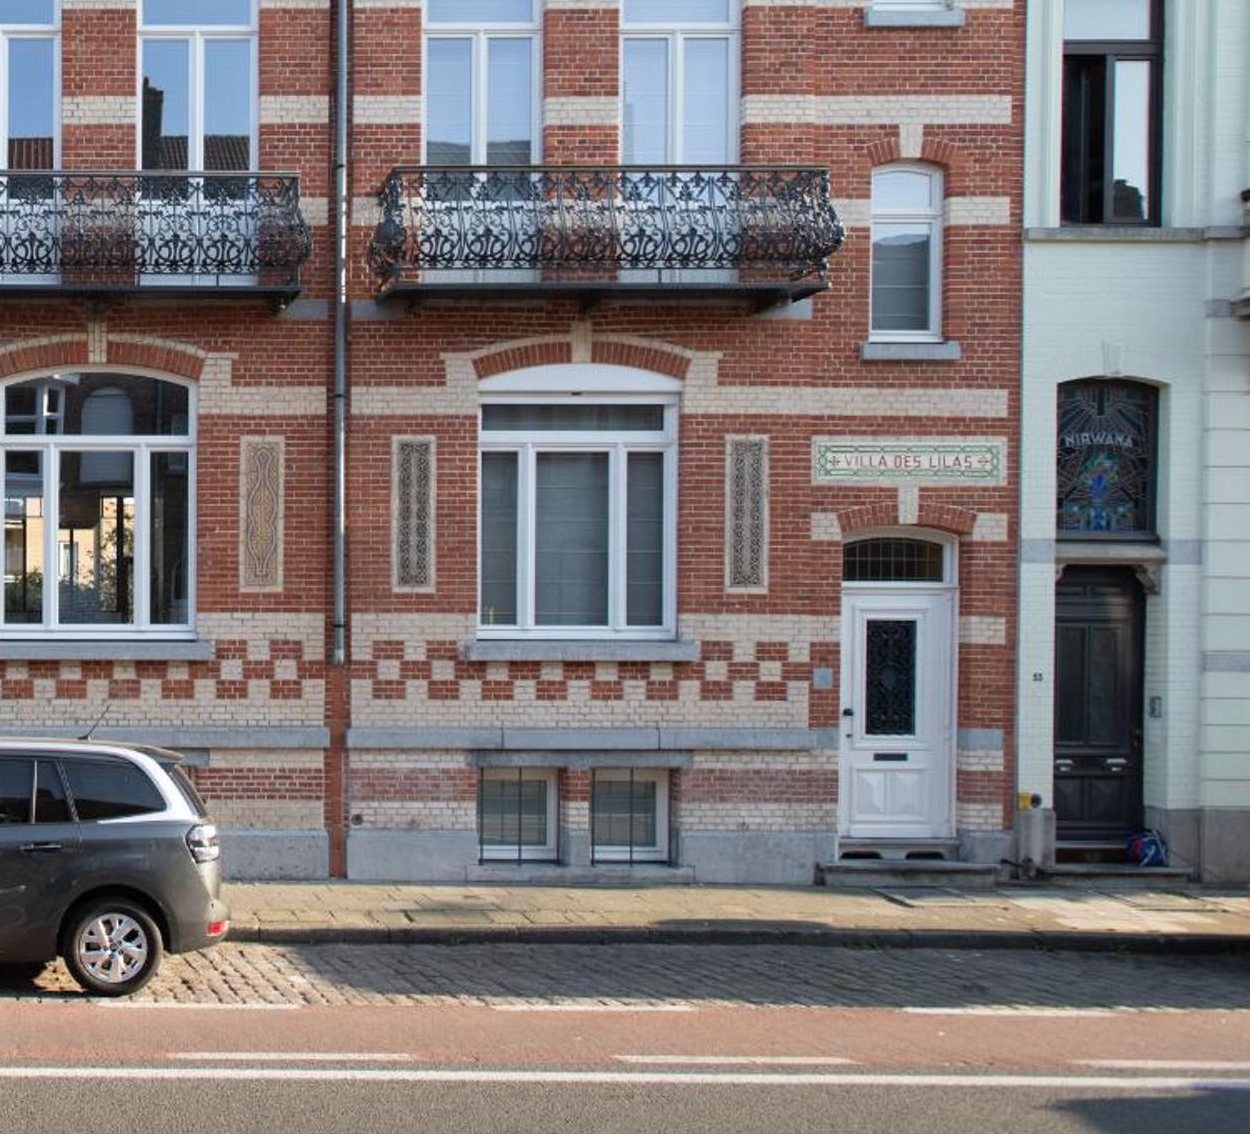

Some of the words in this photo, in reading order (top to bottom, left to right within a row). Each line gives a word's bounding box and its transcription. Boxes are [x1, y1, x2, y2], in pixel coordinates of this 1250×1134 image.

[1065, 431, 1133, 447] NIRWANA
[844, 455, 888, 468] VILLA
[894, 455, 921, 468] DES
[929, 455, 973, 468] LILAS
